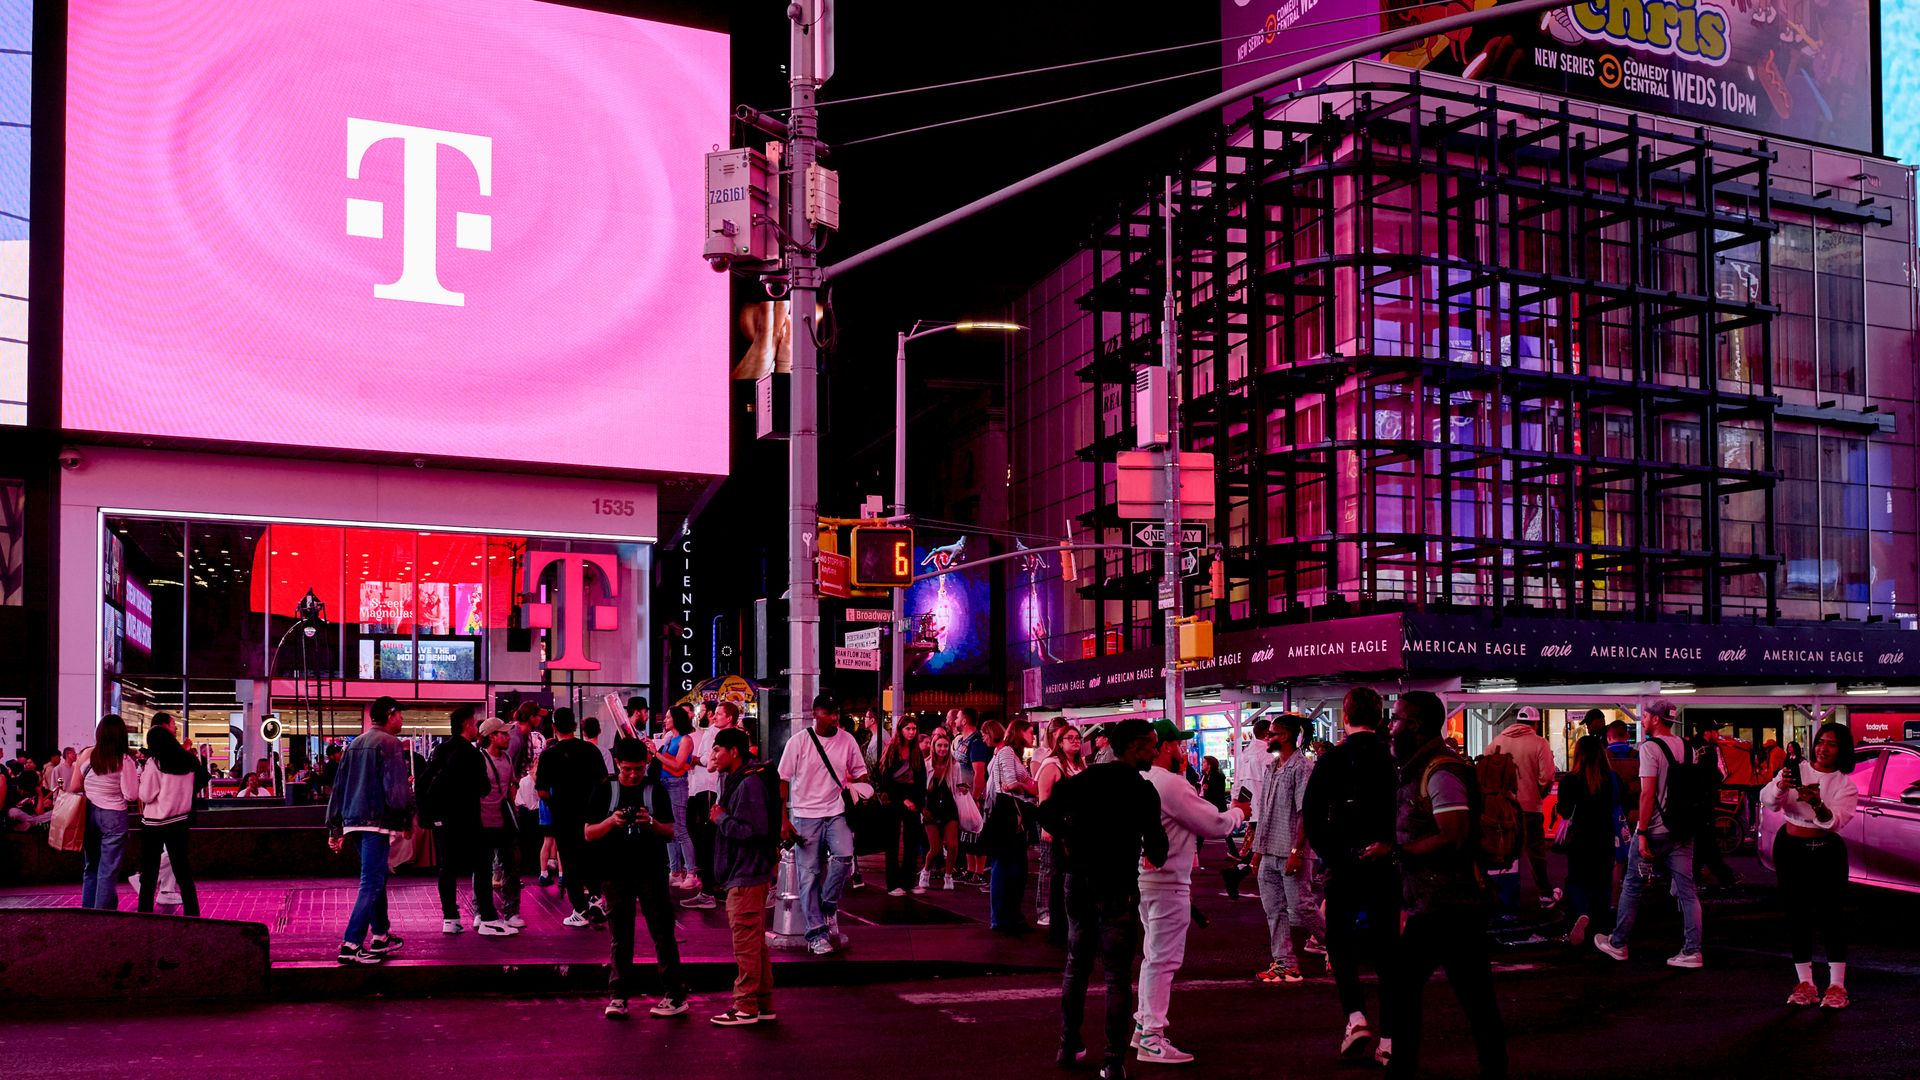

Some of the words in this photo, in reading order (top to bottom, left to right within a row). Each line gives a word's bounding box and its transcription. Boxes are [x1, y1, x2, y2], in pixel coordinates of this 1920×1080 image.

[1534, 47, 1557, 69] NEW
[1560, 53, 1595, 77] SERIES
[1623, 59, 1669, 82] COMEDY
[1623, 78, 1670, 99] CENTRAL
[1671, 70, 1717, 108] WEDS
[1720, 81, 1757, 117] 10PM
[592, 498, 634, 516] 1535
[1143, 530, 1165, 541] ONE
[1182, 531, 1197, 542] AY
[895, 541, 909, 576] 6
[369, 598, 404, 609] Seet
[856, 610, 891, 622] Broadway
[427, 654, 457, 662] BEHIND
[435, 646, 450, 654] THE
[847, 650, 859, 658] FLOW
[860, 651, 871, 659] ZONE
[1219, 652, 1242, 667] EAGLE
[1252, 644, 1275, 663] aerie
[1288, 643, 1344, 658] AMERICAN
[1351, 640, 1388, 654] EAGLE
[1402, 639, 1477, 654] AMERICAN
[1485, 643, 1526, 656] EAGLE
[1541, 640, 1572, 657] aerie
[1590, 646, 1657, 659] AMERICAN
[1665, 648, 1702, 660] EAGLE
[1718, 644, 1747, 662] aerie
[1763, 650, 1824, 662] AMERICAN
[1830, 651, 1864, 662] EAGLE
[1878, 649, 1904, 665] aerie
[855, 660, 871, 668] MOVING
[1045, 682, 1069, 694] AMERICAN
[1070, 679, 1085, 691] EAGLE
[1107, 672, 1135, 685] AMERICAN
[1136, 668, 1154, 680] EAGLE
